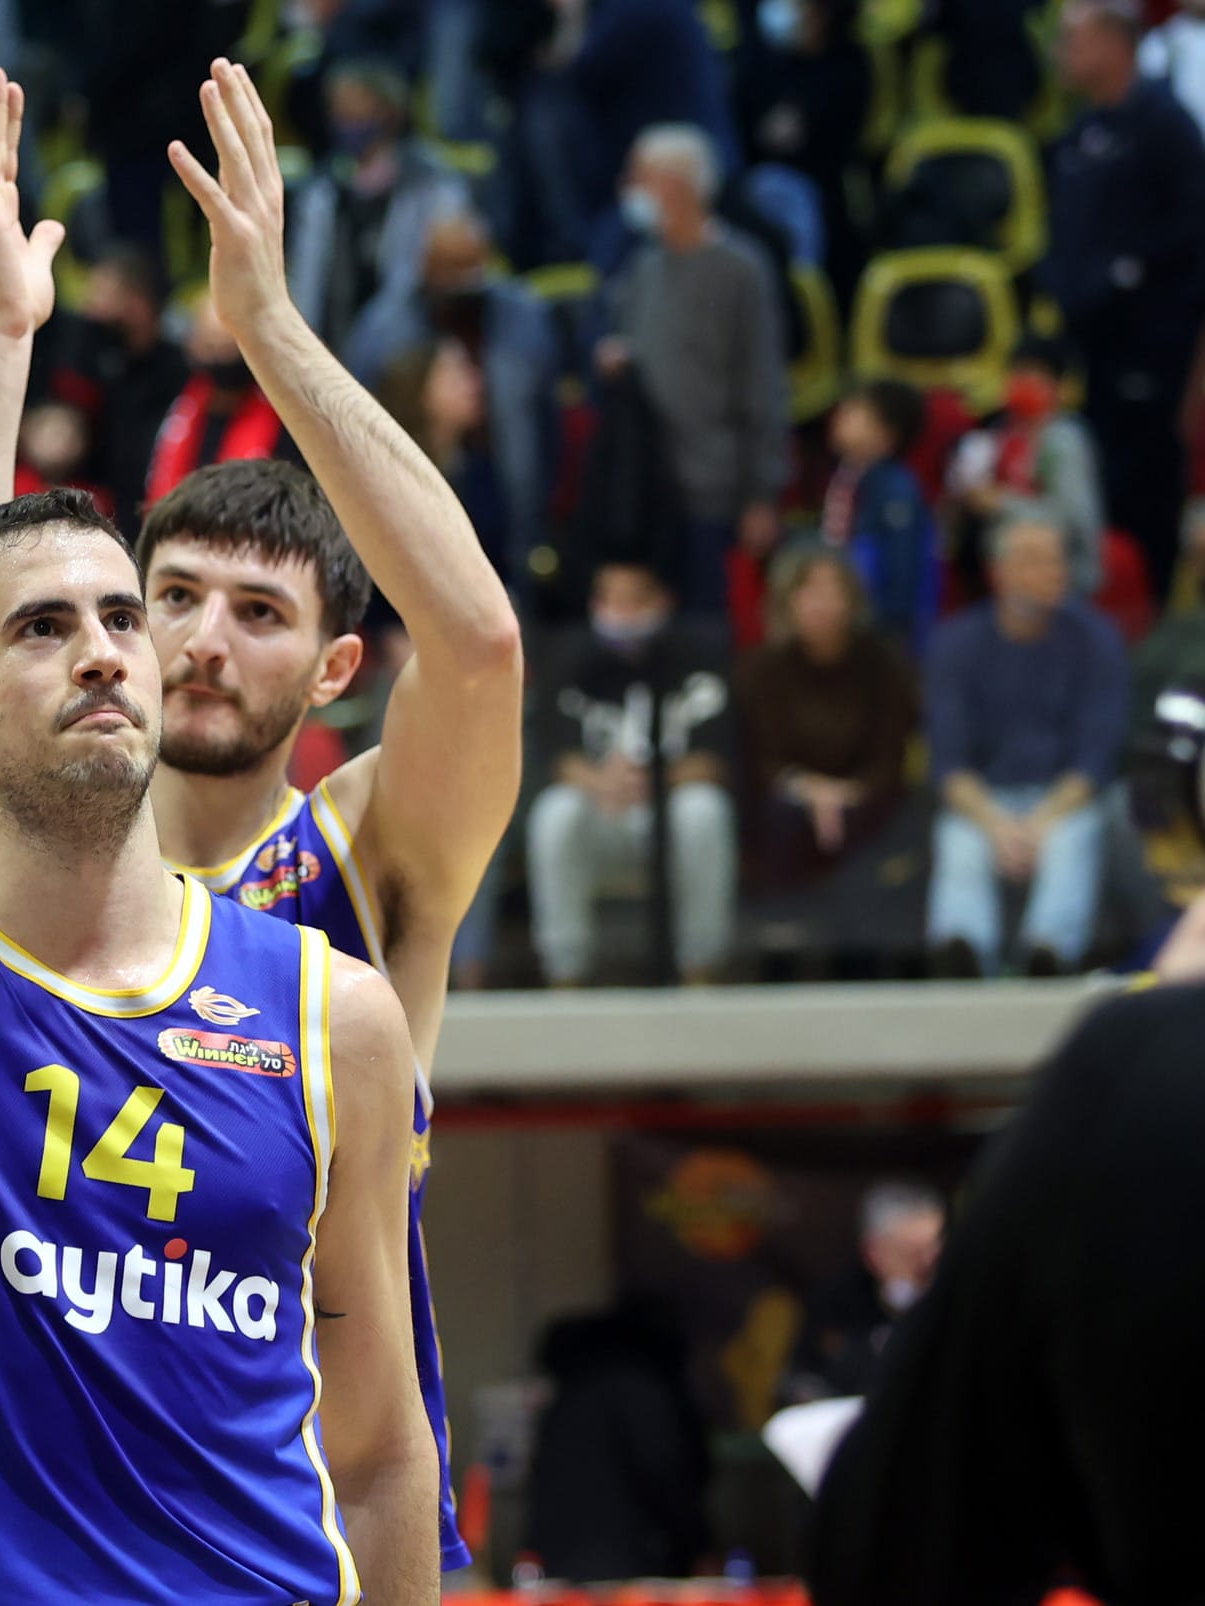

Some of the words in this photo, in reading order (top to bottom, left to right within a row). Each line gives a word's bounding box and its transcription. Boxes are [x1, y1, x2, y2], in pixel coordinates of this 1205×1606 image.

[173, 1037, 260, 1066] Winner
[229, 1041, 258, 1056] ליגת
[261, 1053, 282, 1070] סל
[25, 1064, 196, 1222] 14
